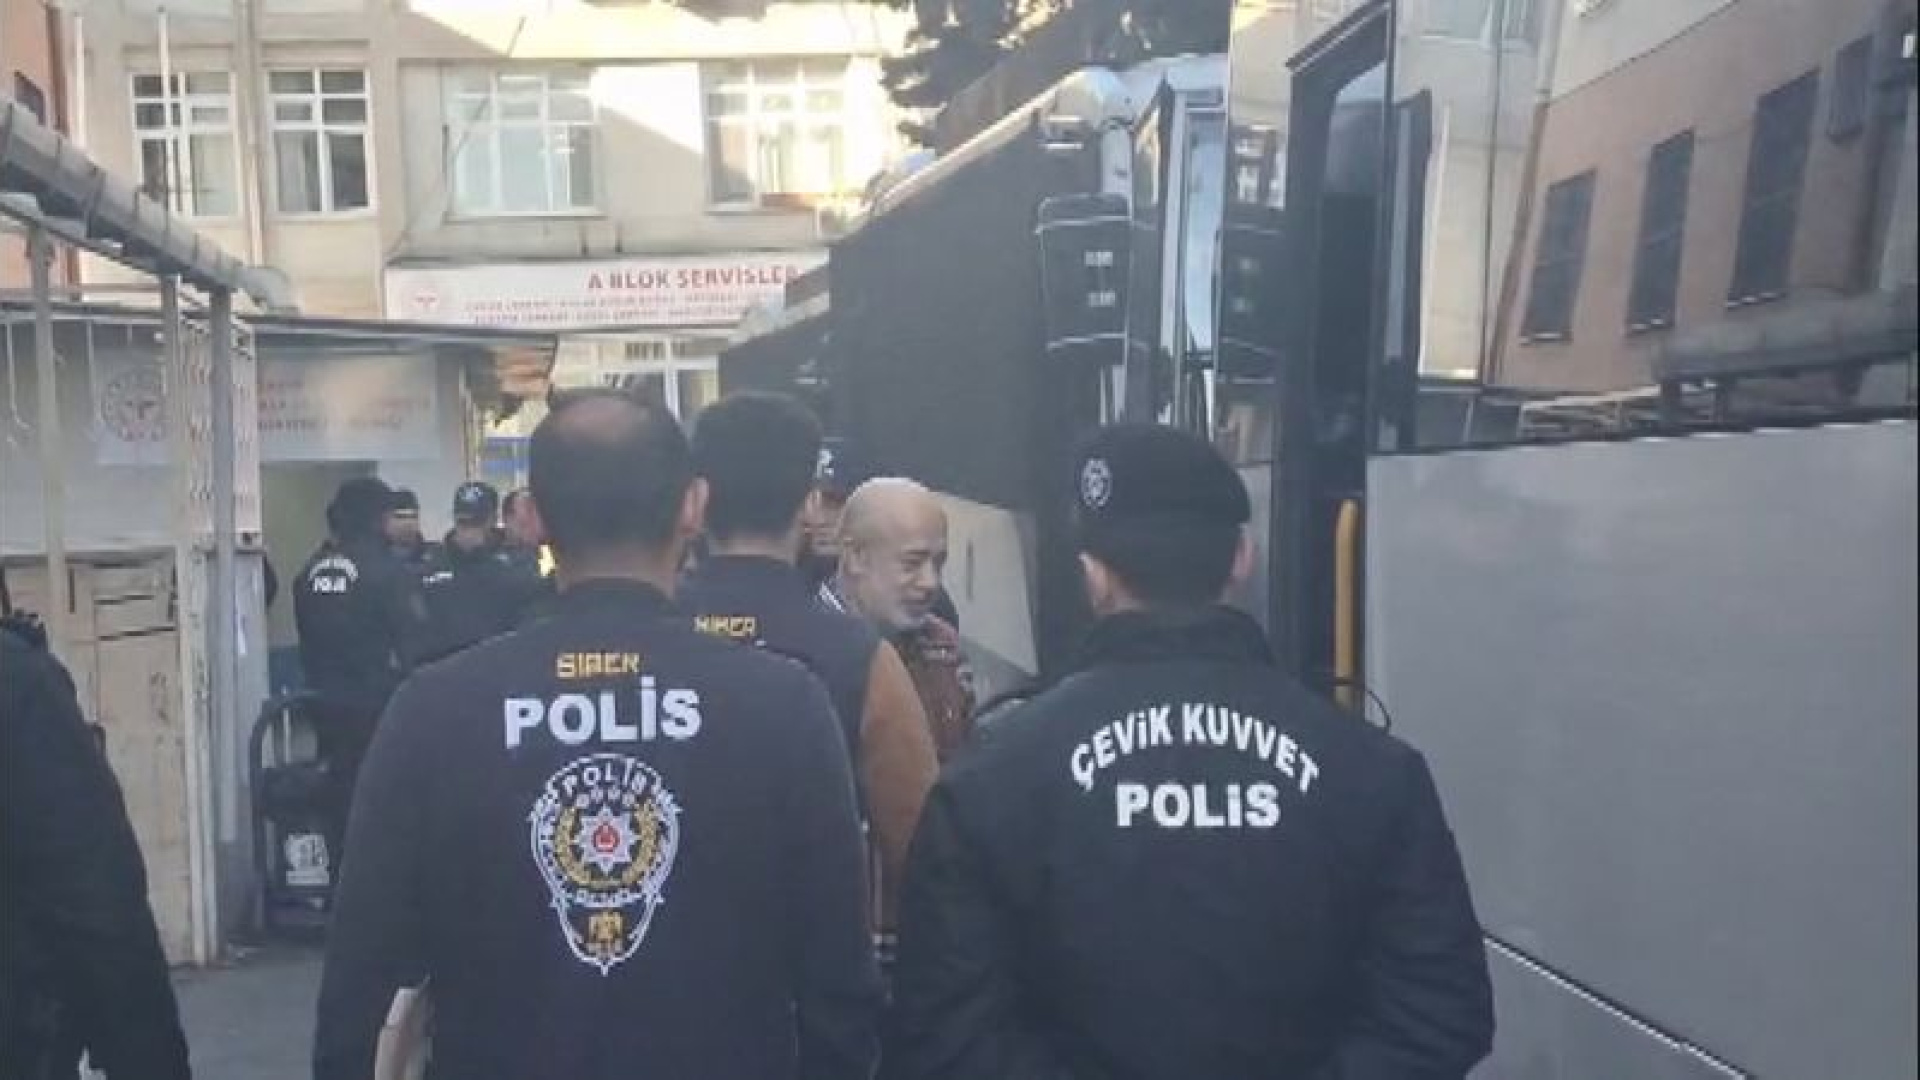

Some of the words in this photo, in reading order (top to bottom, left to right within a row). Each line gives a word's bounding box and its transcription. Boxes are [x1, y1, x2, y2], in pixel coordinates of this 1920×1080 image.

[588, 270, 603, 289] A
[610, 269, 670, 289] BLOK
[504, 675, 701, 749] POLİS
[1181, 702, 1320, 793] KUVVET
[1116, 781, 1281, 827] POLİS
